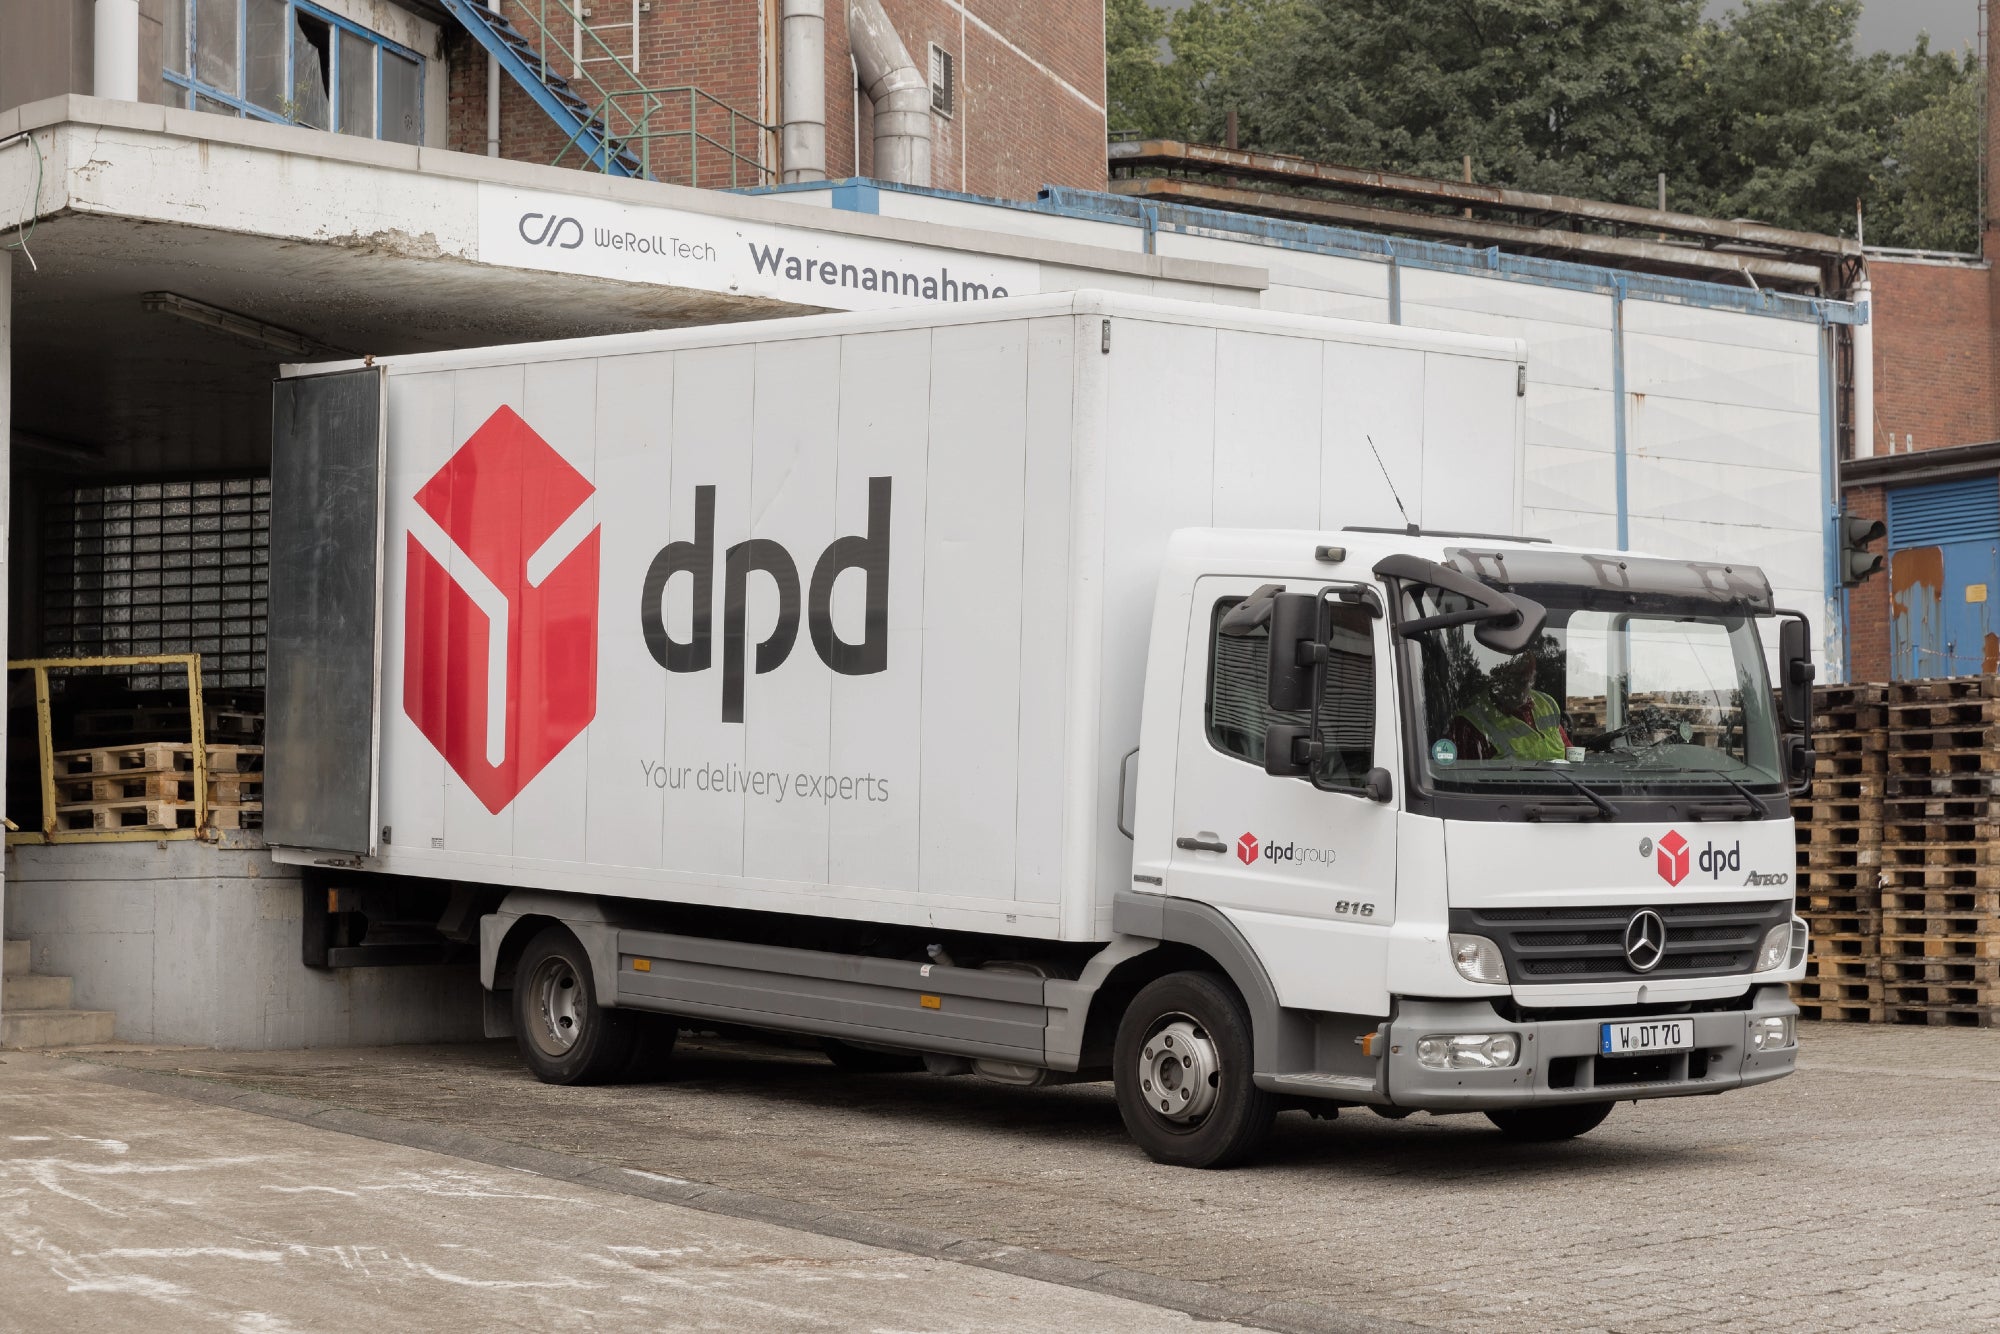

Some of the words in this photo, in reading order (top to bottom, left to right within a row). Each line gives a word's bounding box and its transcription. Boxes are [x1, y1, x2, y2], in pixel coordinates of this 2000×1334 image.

[594, 227, 667, 256] WeRoll
[669, 237, 716, 262] Tech
[641, 476, 892, 724] dpd
[640, 759, 692, 789] Your
[696, 762, 790, 803] delivery
[794, 772, 890, 806] experts
[1698, 840, 1741, 880] dpd
[1334, 900, 1376, 917] 816
[1620, 1027, 1629, 1049] W
